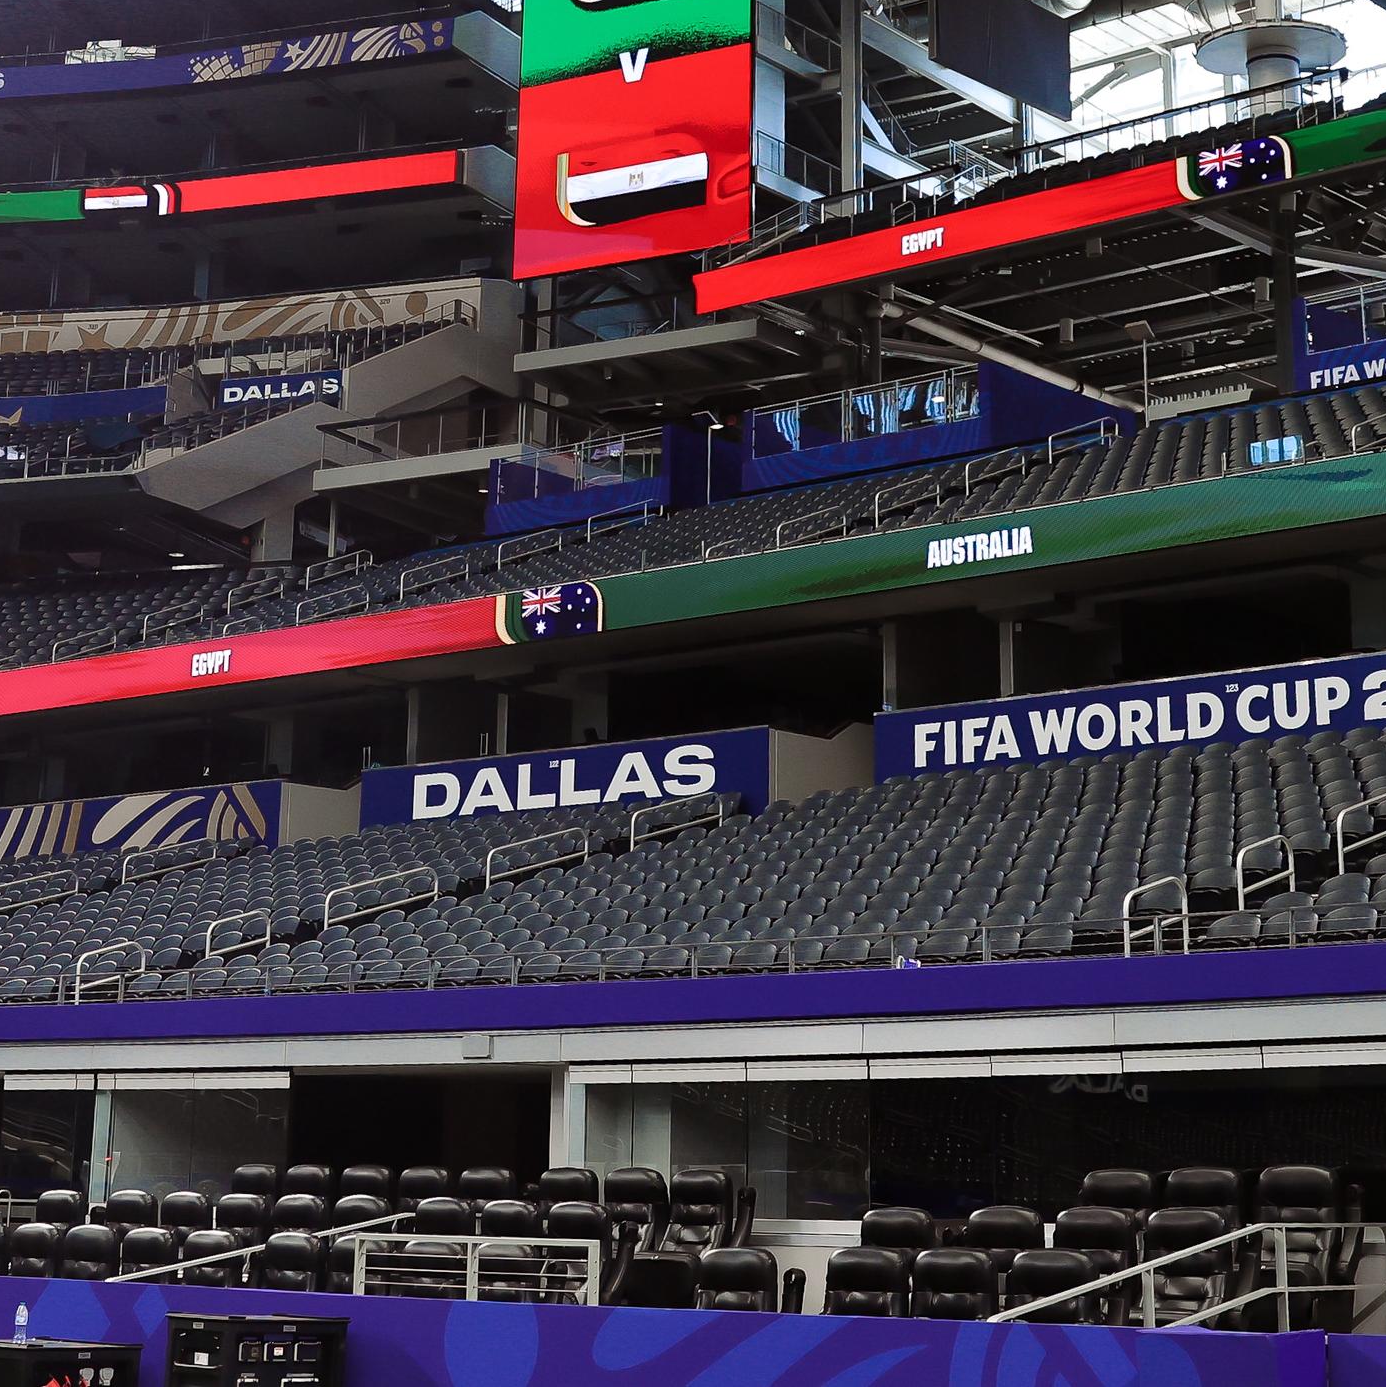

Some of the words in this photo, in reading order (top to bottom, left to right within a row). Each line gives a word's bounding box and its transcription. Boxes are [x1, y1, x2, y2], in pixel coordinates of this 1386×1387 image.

[901, 226, 945, 255] EGYPT
[223, 378, 339, 403] DALLAS
[1310, 365, 1361, 389] FIFA
[927, 526, 1032, 570] AUSTRALIA
[191, 650, 231, 676] EGYPT
[1225, 684, 1239, 692] 123
[914, 714, 1021, 768] FIFA
[1028, 693, 1223, 755] WORLD
[1235, 675, 1349, 733] CUP
[412, 744, 716, 820] DALLAS
